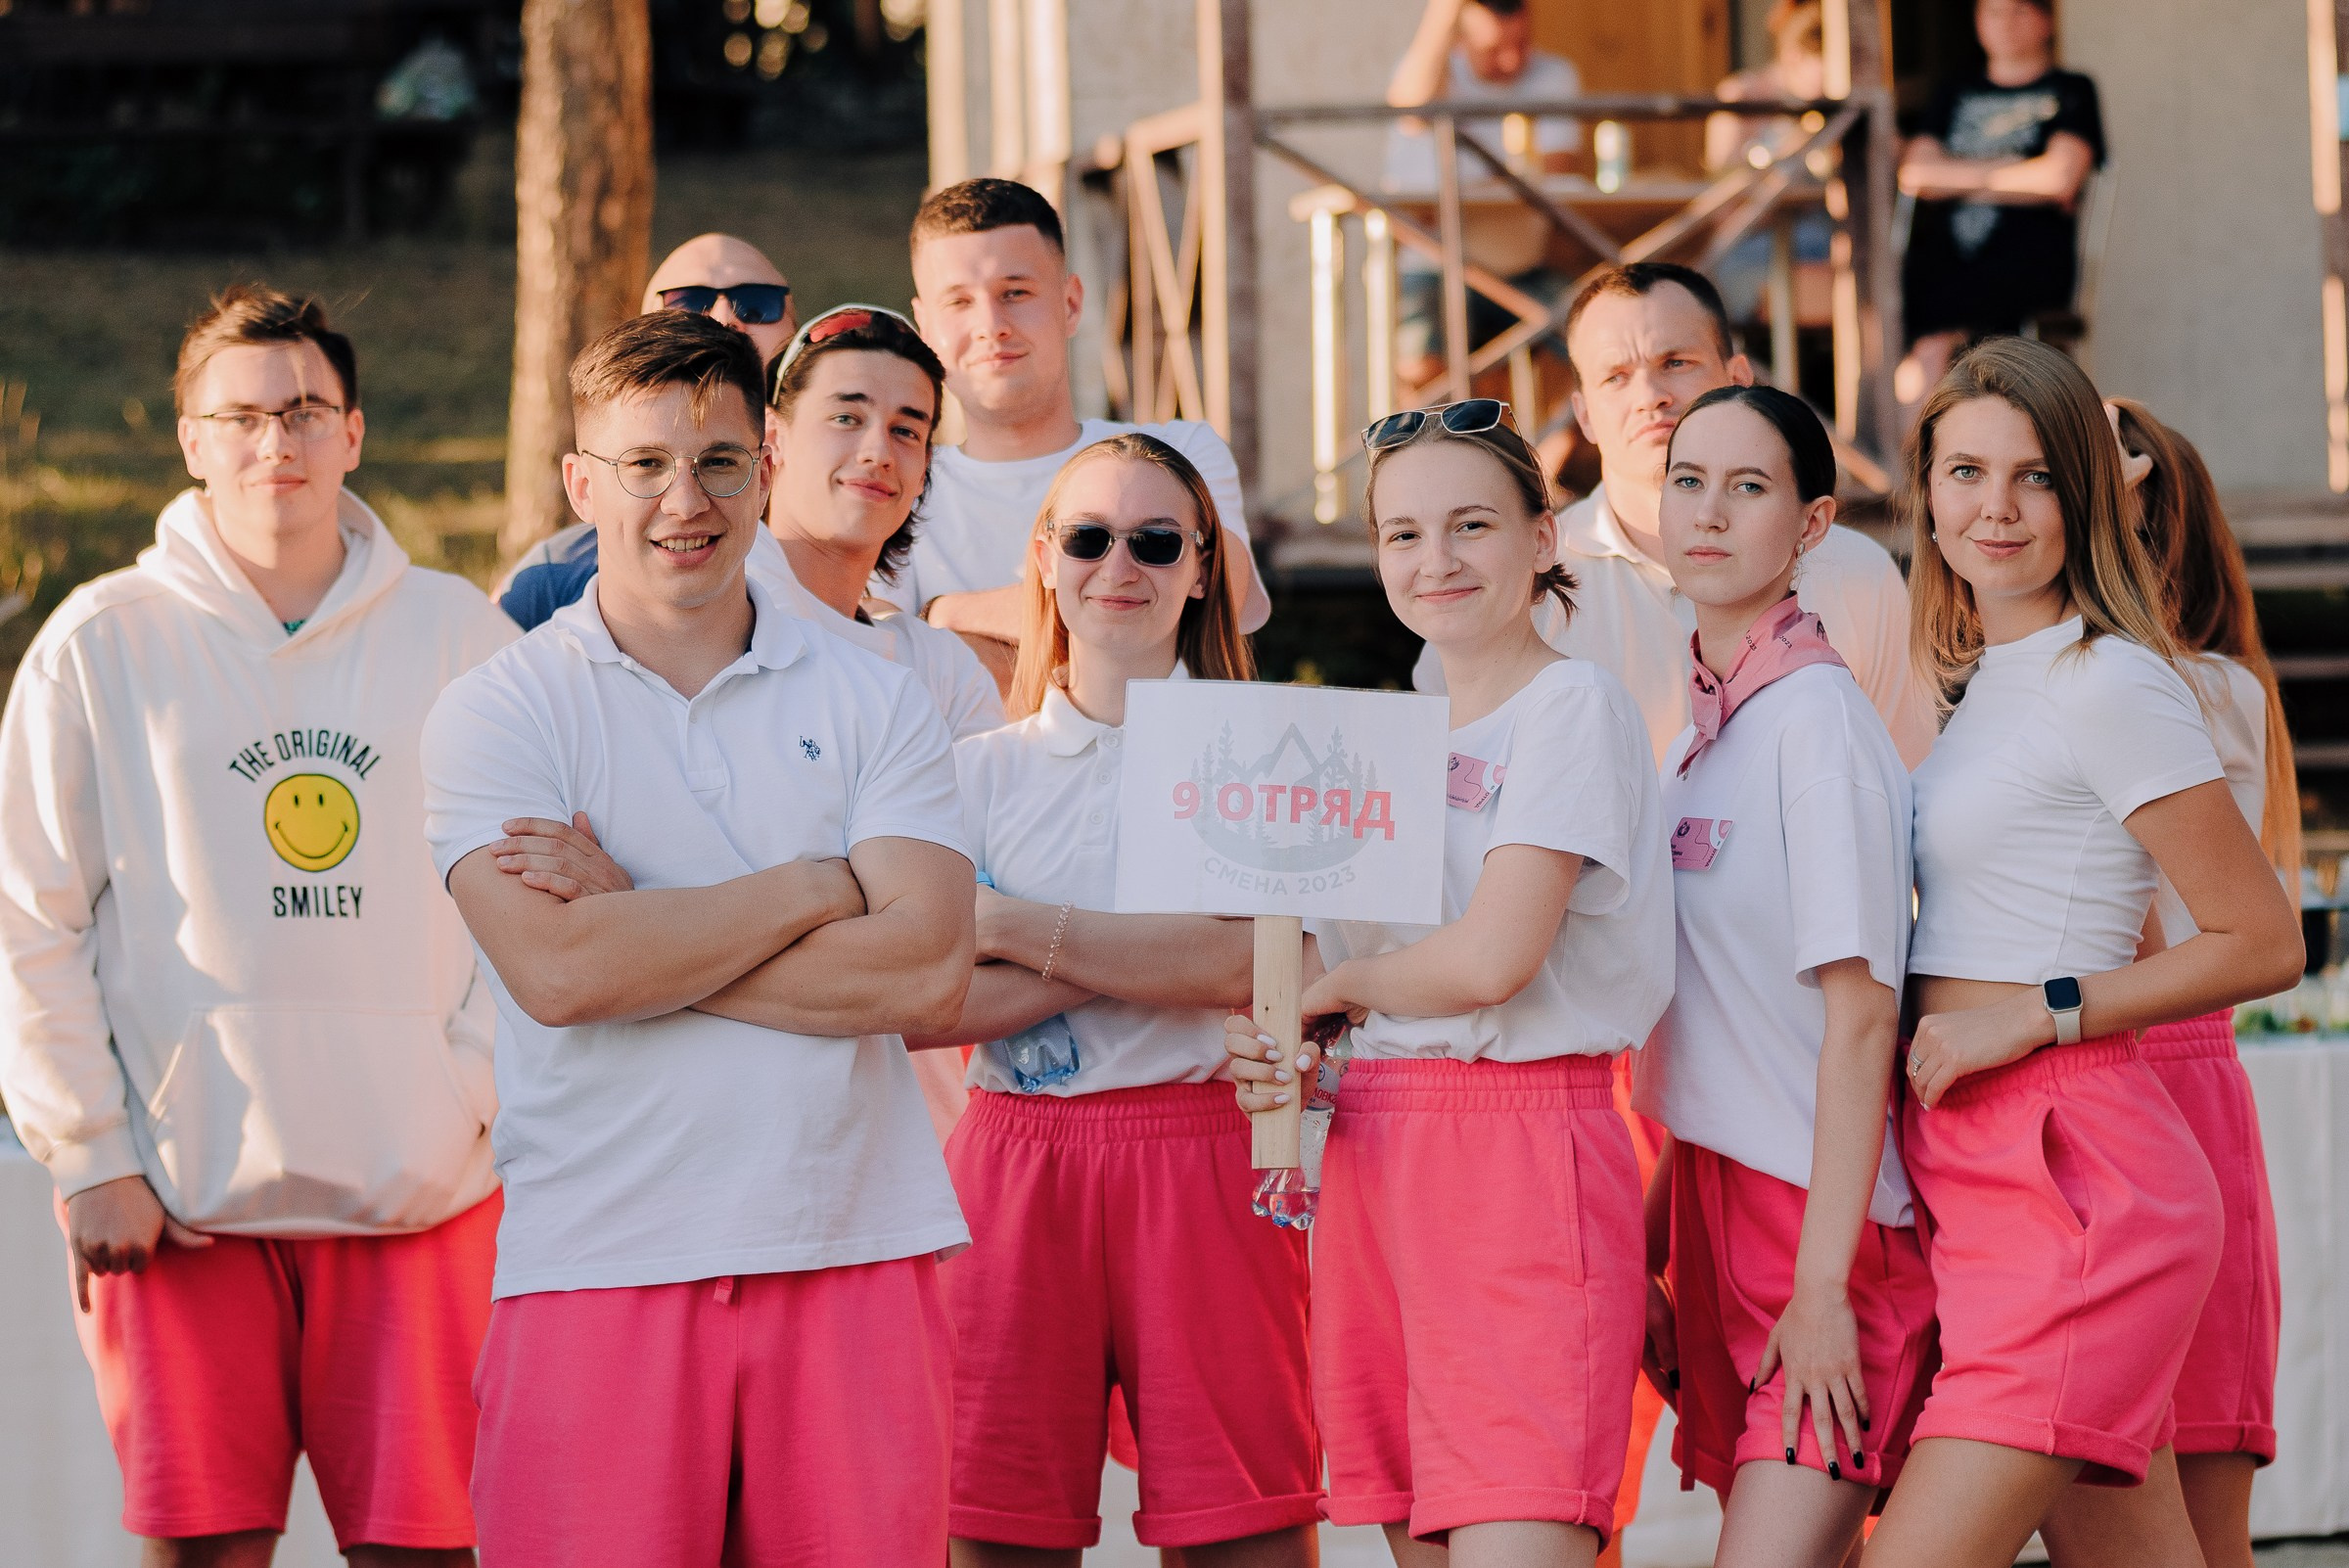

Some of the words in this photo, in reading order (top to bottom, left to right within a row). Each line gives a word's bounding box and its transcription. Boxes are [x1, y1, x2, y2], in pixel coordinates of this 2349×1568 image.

[228, 741, 276, 783] THE
[274, 729, 383, 781] ORIGINAL
[1172, 781, 1201, 820] 9
[1217, 783, 1396, 842] ОТРЯД
[1204, 856, 1288, 896] СМЕНА
[1298, 865, 1357, 895] 2023
[273, 885, 362, 919] SMILEY
